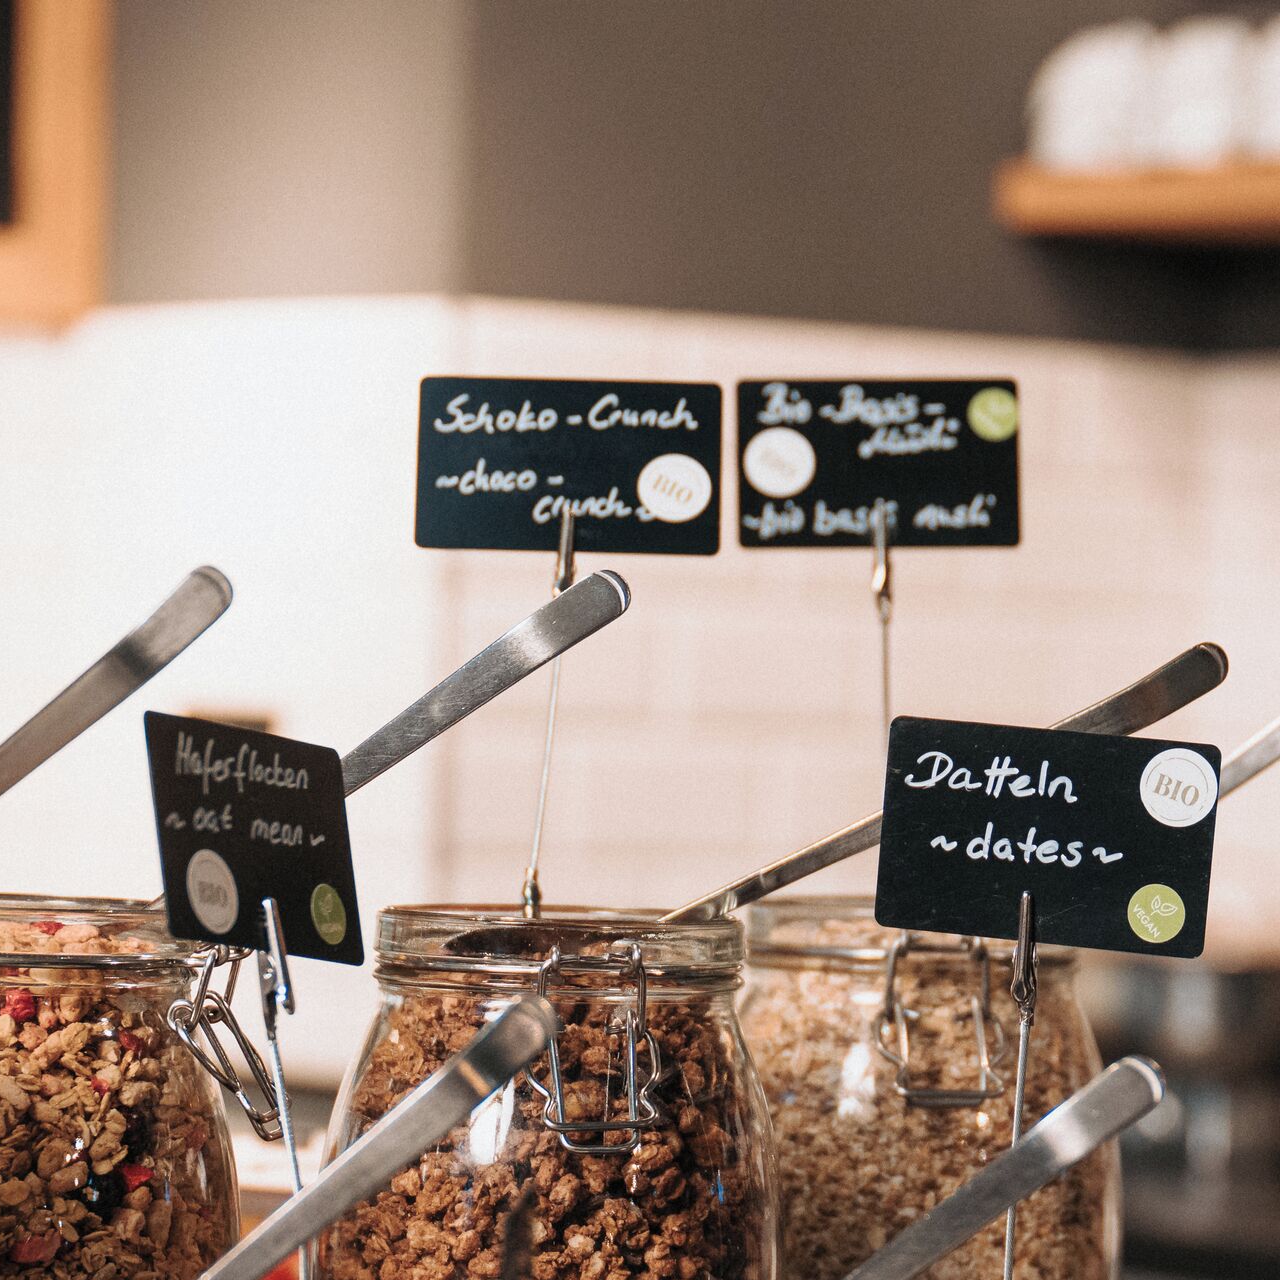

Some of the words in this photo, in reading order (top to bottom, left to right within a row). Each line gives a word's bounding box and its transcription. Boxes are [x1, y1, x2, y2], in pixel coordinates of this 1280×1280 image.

[904, 751, 1078, 804] Datteln
[1153, 773, 1200, 808] BIO
[1132, 904, 1161, 939] VEGAN
